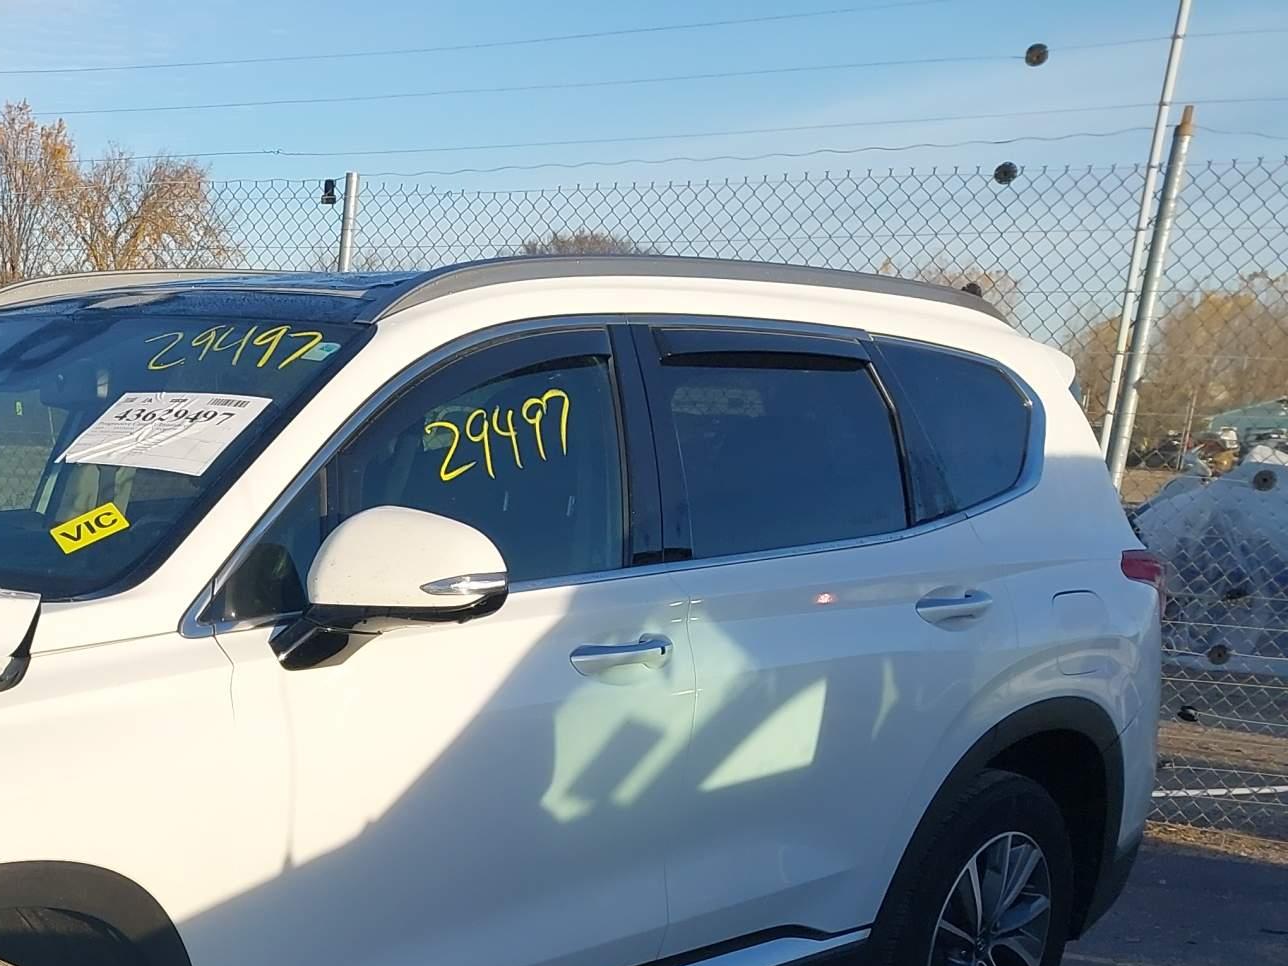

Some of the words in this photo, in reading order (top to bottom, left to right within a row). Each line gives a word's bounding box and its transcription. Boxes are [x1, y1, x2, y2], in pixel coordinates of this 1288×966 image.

[145, 325, 322, 370] 29497
[114, 407, 236, 426] 43629497
[424, 388, 570, 482] 29497
[61, 510, 119, 543] VIC
